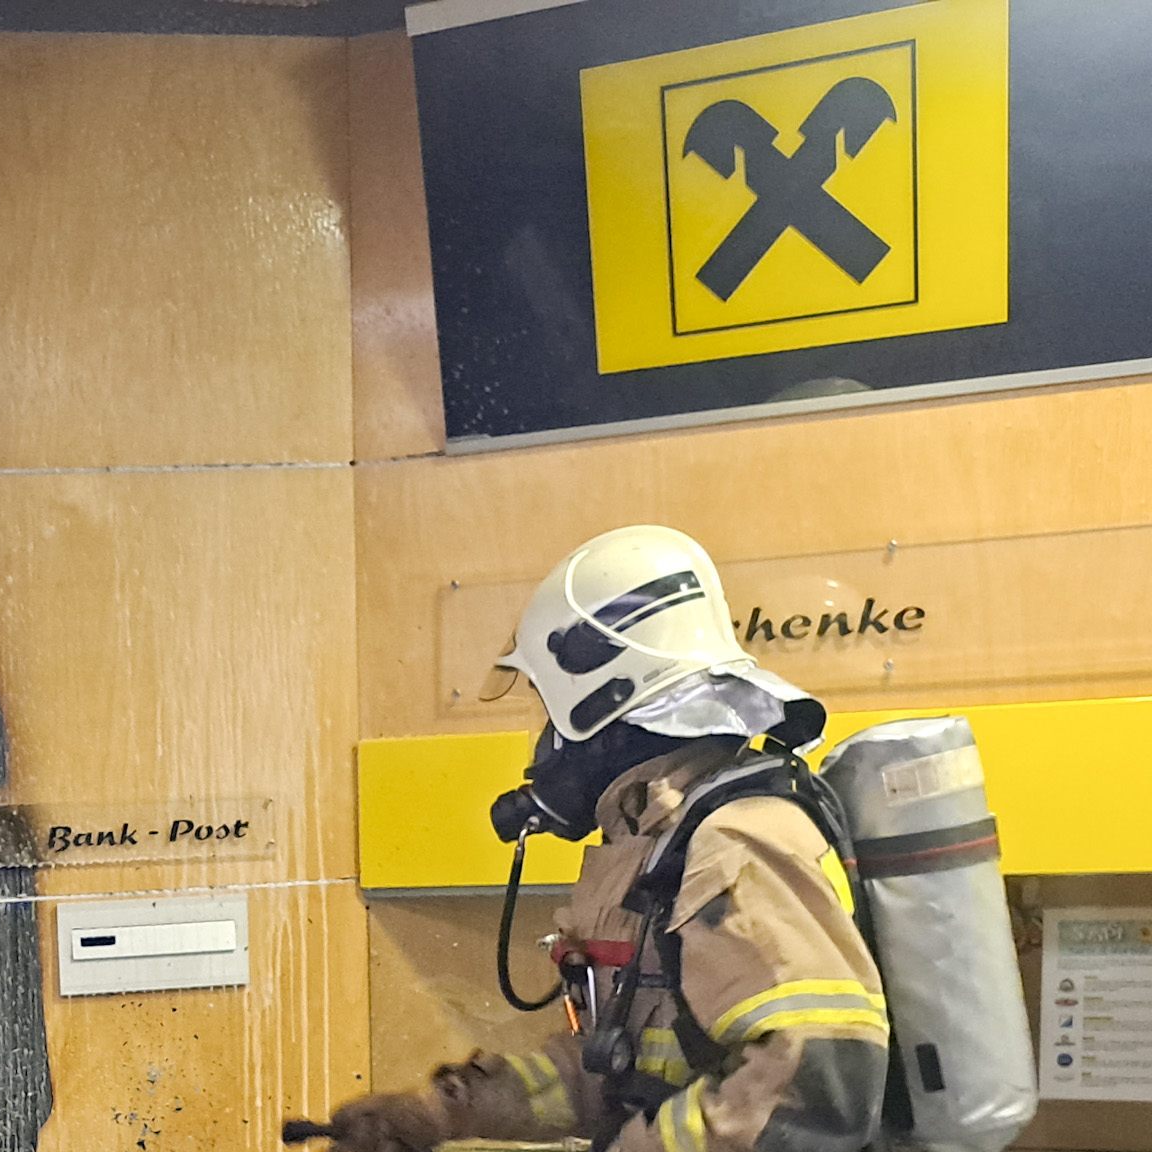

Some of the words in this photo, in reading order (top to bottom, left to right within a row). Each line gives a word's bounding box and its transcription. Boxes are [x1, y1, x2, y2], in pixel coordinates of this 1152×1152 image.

[733, 597, 926, 642] henke
[48, 822, 138, 853] Bank
[169, 818, 249, 842] Post
